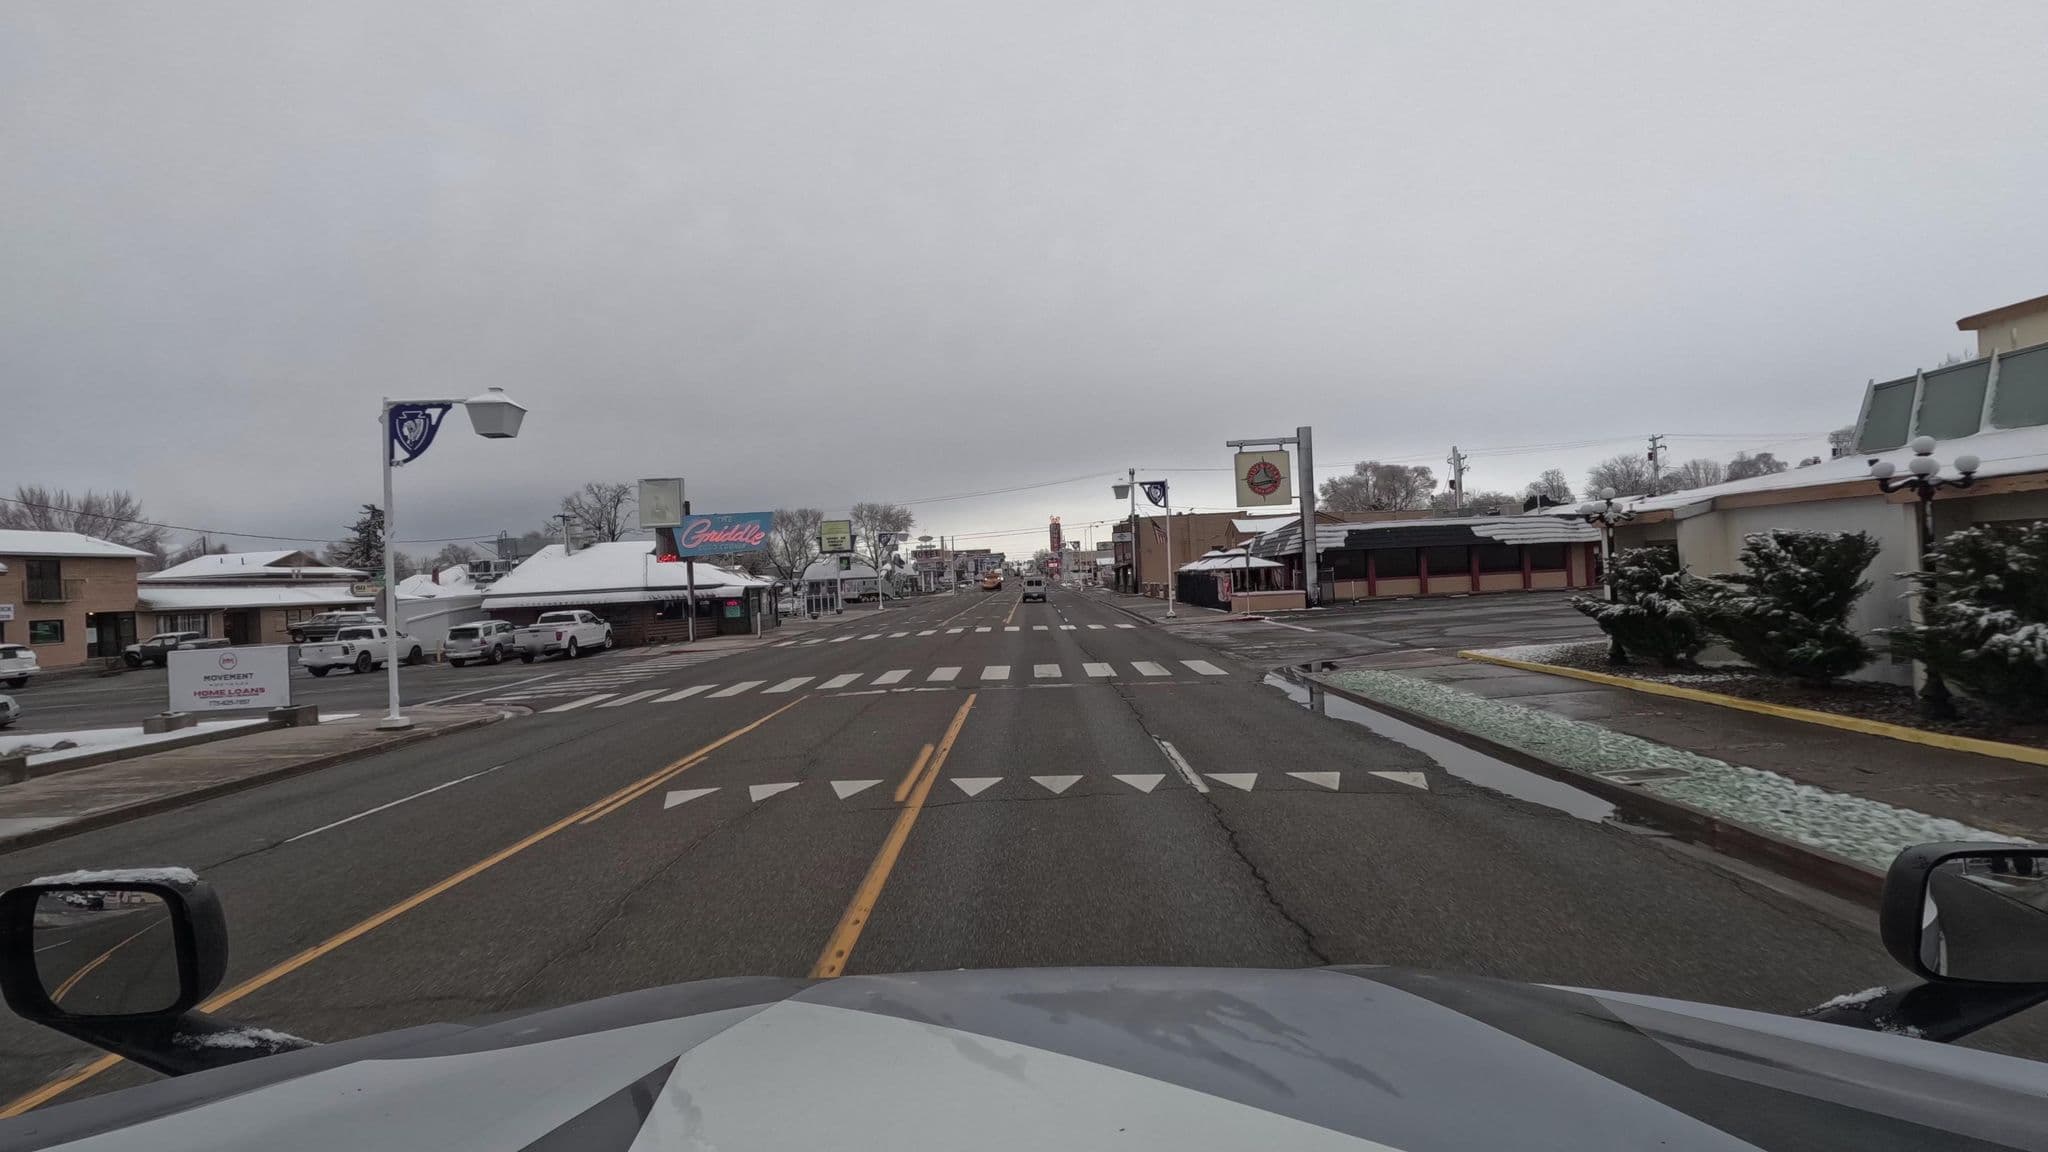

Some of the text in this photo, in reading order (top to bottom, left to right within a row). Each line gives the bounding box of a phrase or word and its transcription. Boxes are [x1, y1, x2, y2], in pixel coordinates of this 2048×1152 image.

[681, 519, 766, 548] Griddle
[203, 673, 254, 682] MOVEMENT
[193, 689, 225, 697] HOME
[228, 687, 265, 695] LOANS
